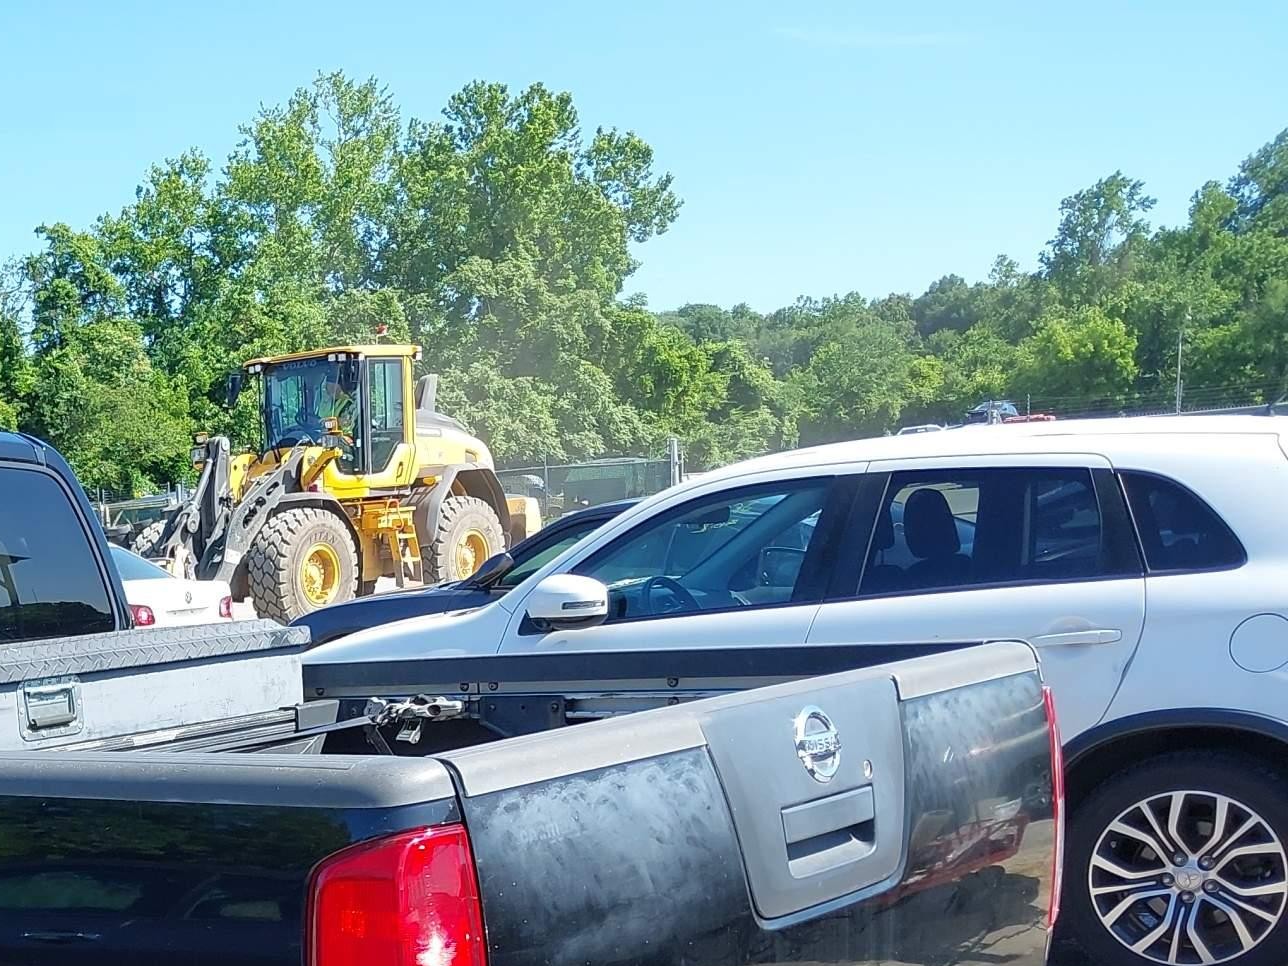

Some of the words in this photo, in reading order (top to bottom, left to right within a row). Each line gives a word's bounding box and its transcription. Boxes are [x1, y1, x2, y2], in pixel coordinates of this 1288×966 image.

[282, 359, 318, 370] VOLVO
[309, 531, 338, 545] TITAN
[806, 736, 841, 751] NISSA
